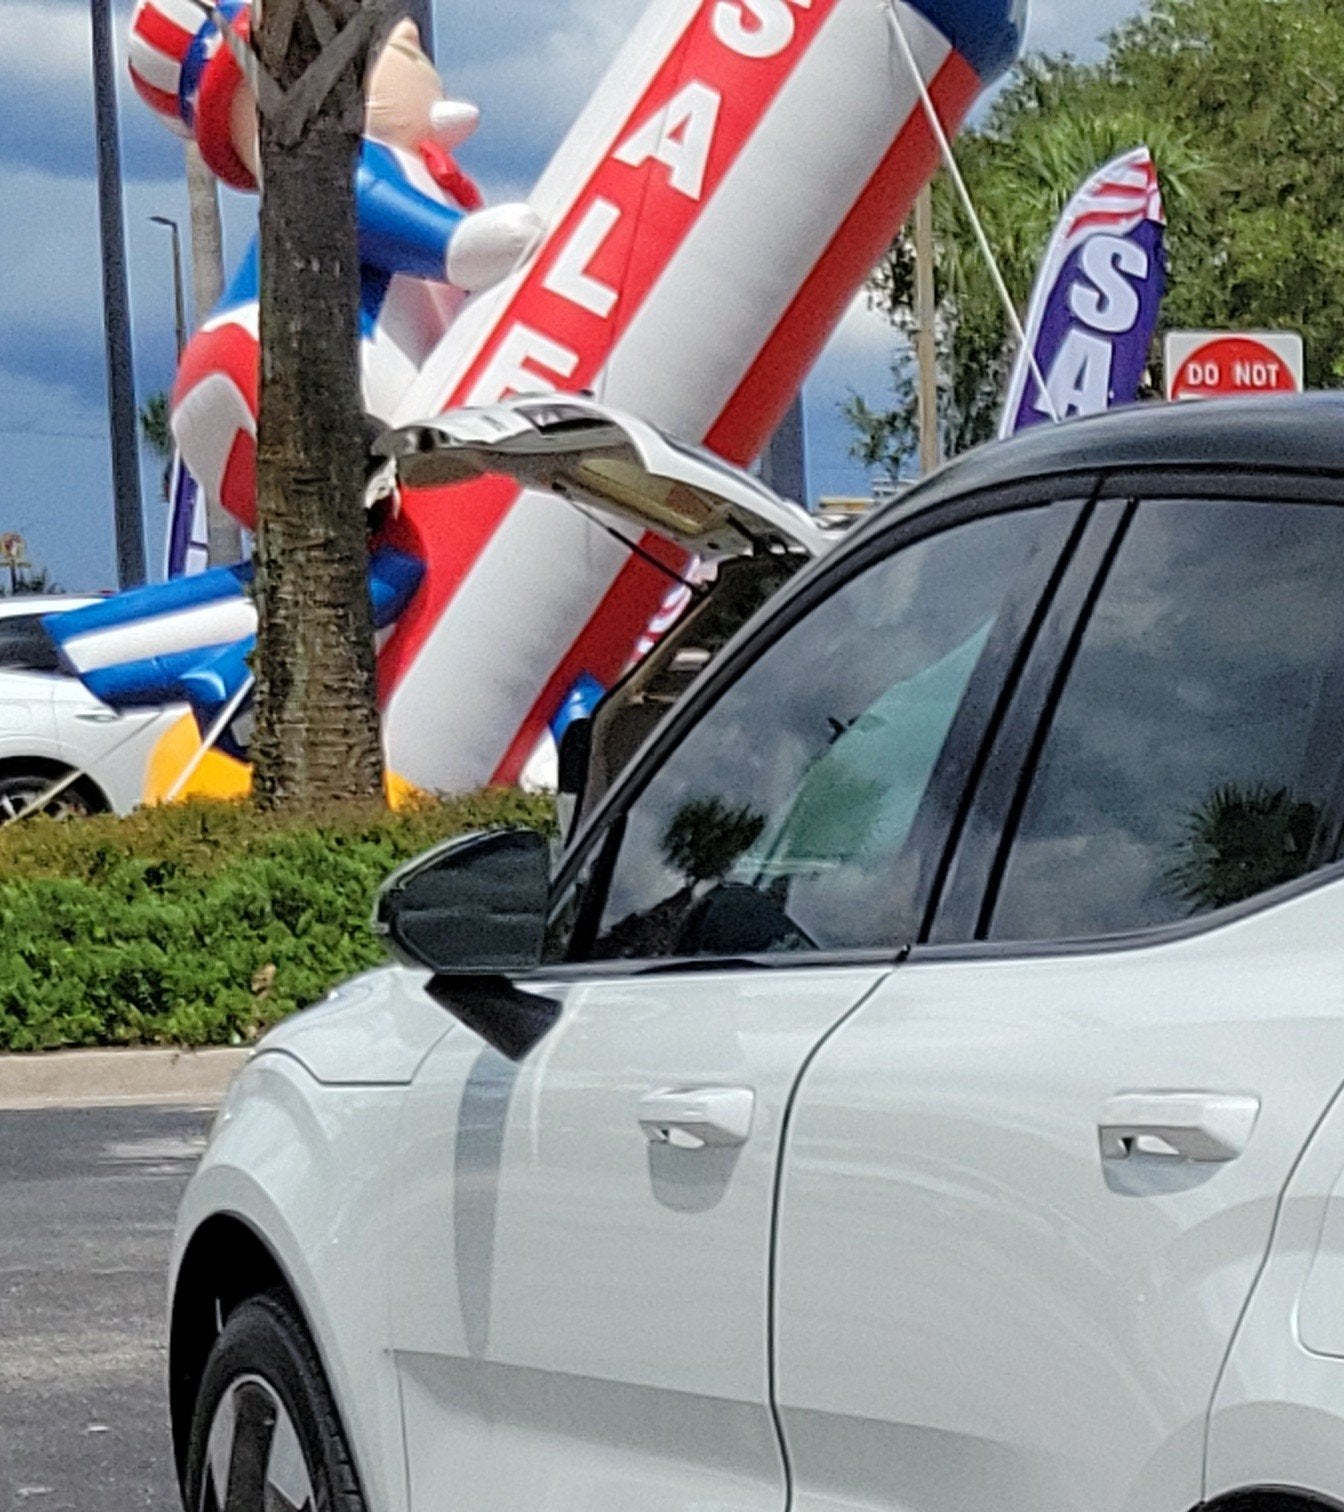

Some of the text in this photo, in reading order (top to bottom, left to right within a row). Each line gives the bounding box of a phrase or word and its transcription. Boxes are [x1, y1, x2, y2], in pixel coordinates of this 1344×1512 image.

[1033, 234, 1148, 417] SA
[1187, 361, 1280, 388] DO NOT
